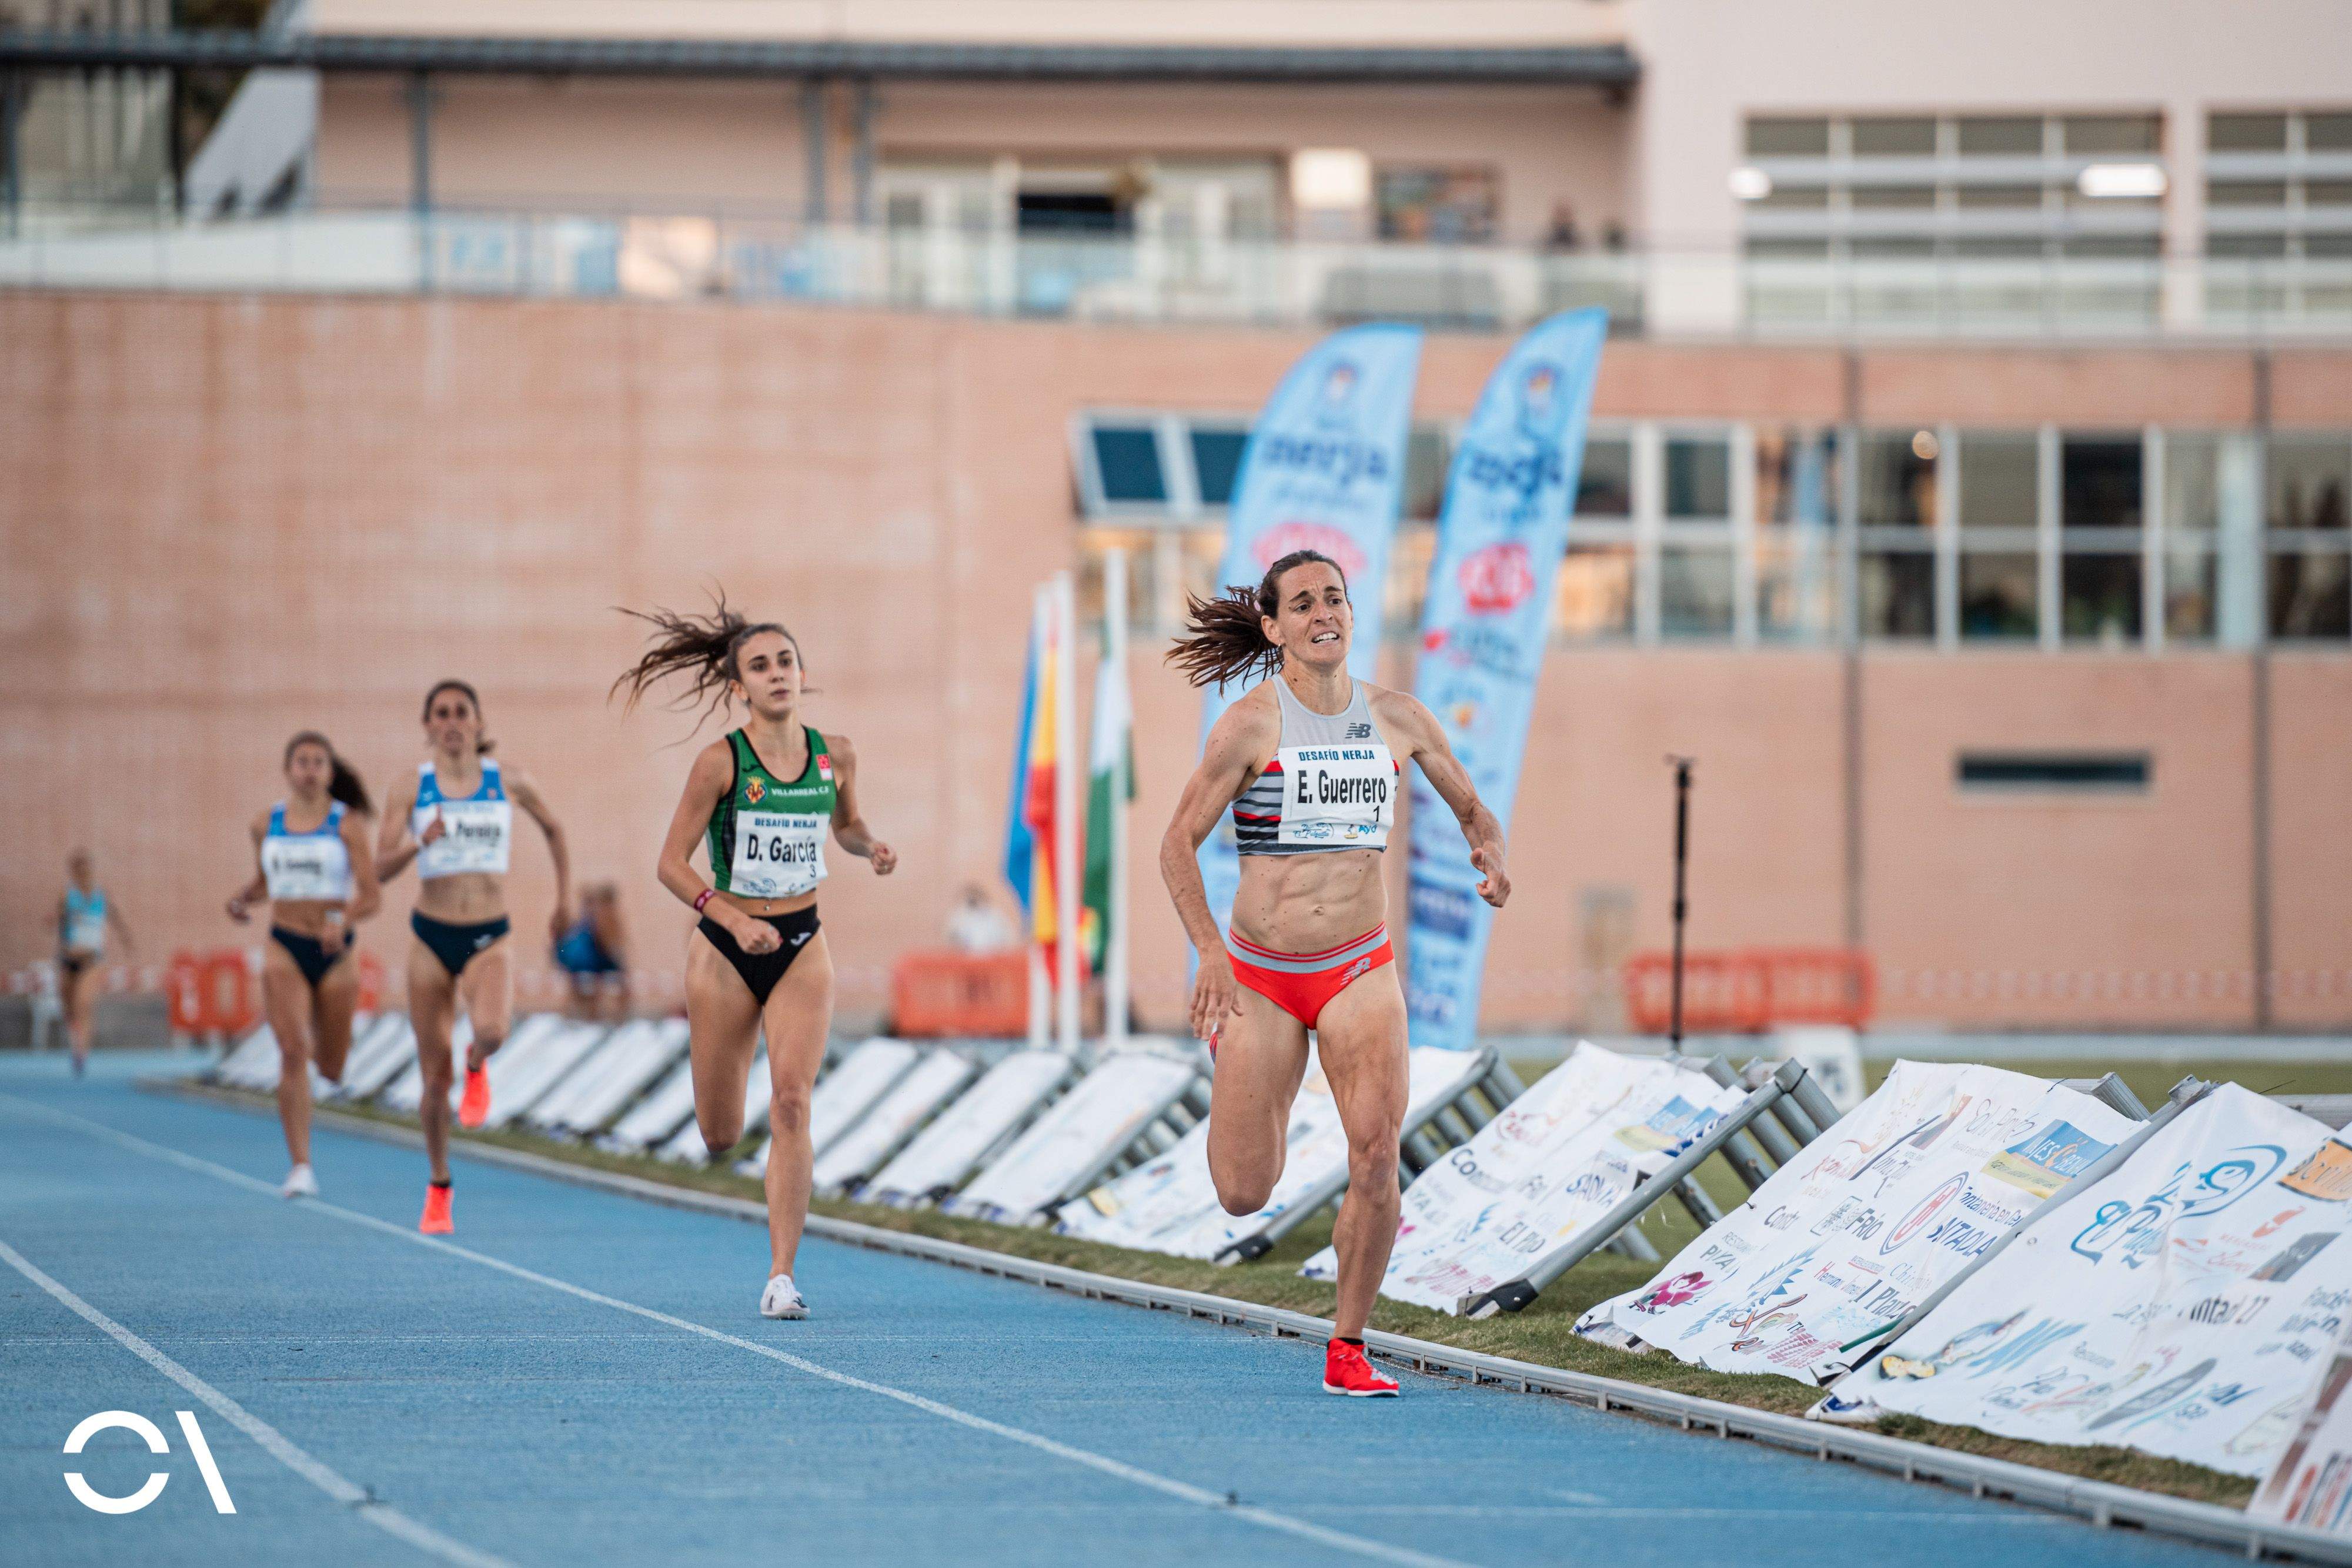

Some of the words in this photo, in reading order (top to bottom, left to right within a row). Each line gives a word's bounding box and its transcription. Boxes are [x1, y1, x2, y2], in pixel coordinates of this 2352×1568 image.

[1298, 750, 1338, 761] DESAFÍO
[1342, 750, 1375, 760] NERJA
[771, 787, 818, 797] VILLARREAL
[1298, 770, 1312, 804] E.
[1319, 770, 1387, 804] Guerrero
[1374, 805, 1380, 822] 1
[755, 817, 789, 828] DESAFÍO
[793, 819, 817, 828] NERJA
[747, 834, 762, 860] D.
[770, 835, 817, 862] García
[810, 864, 817, 878] 3
